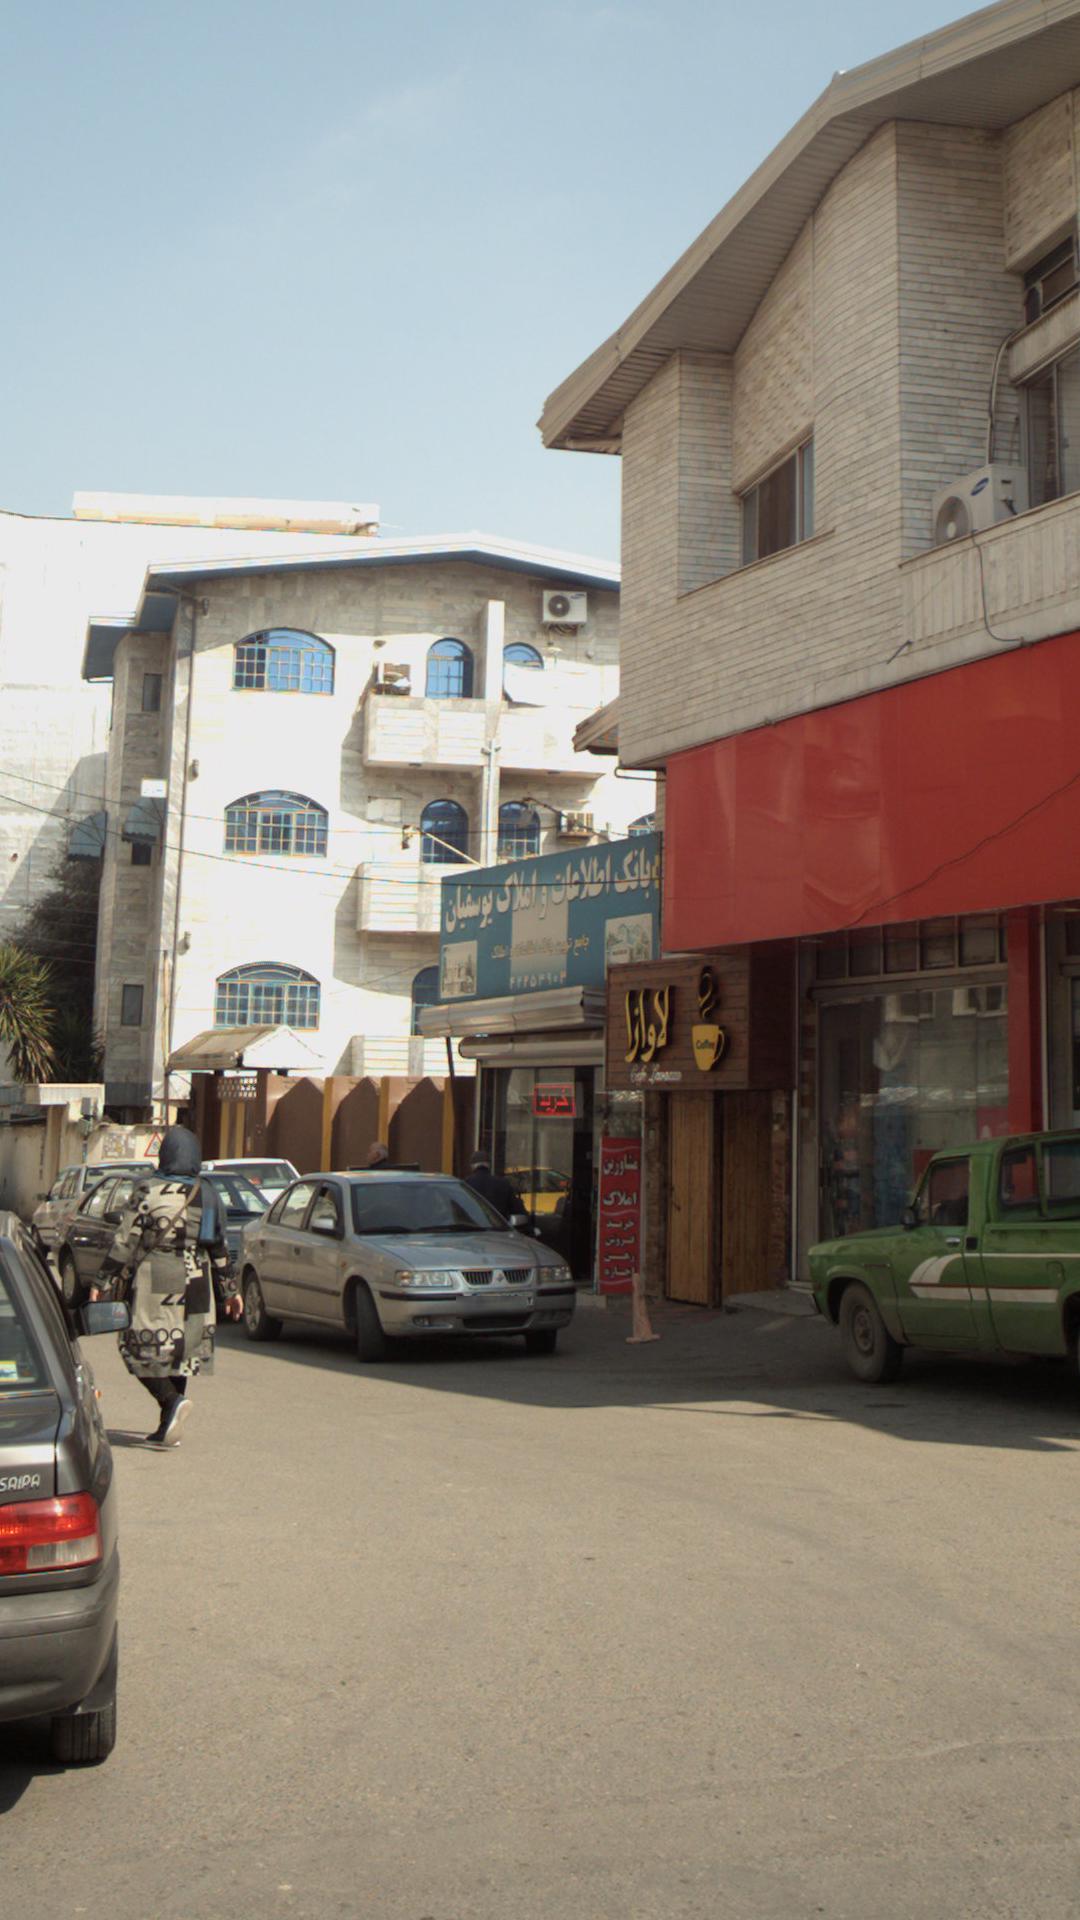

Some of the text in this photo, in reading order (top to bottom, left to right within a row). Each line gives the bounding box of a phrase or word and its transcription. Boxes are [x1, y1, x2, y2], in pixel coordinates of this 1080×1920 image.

[496, 868, 537, 913] املاک
[551, 854, 611, 904] اطلاعات
[614, 848, 651, 898] بانک
[538, 884, 548, 919] و
[603, 1190, 638, 1206] املاک
[0, 1473, 41, 1492] SAIPA
